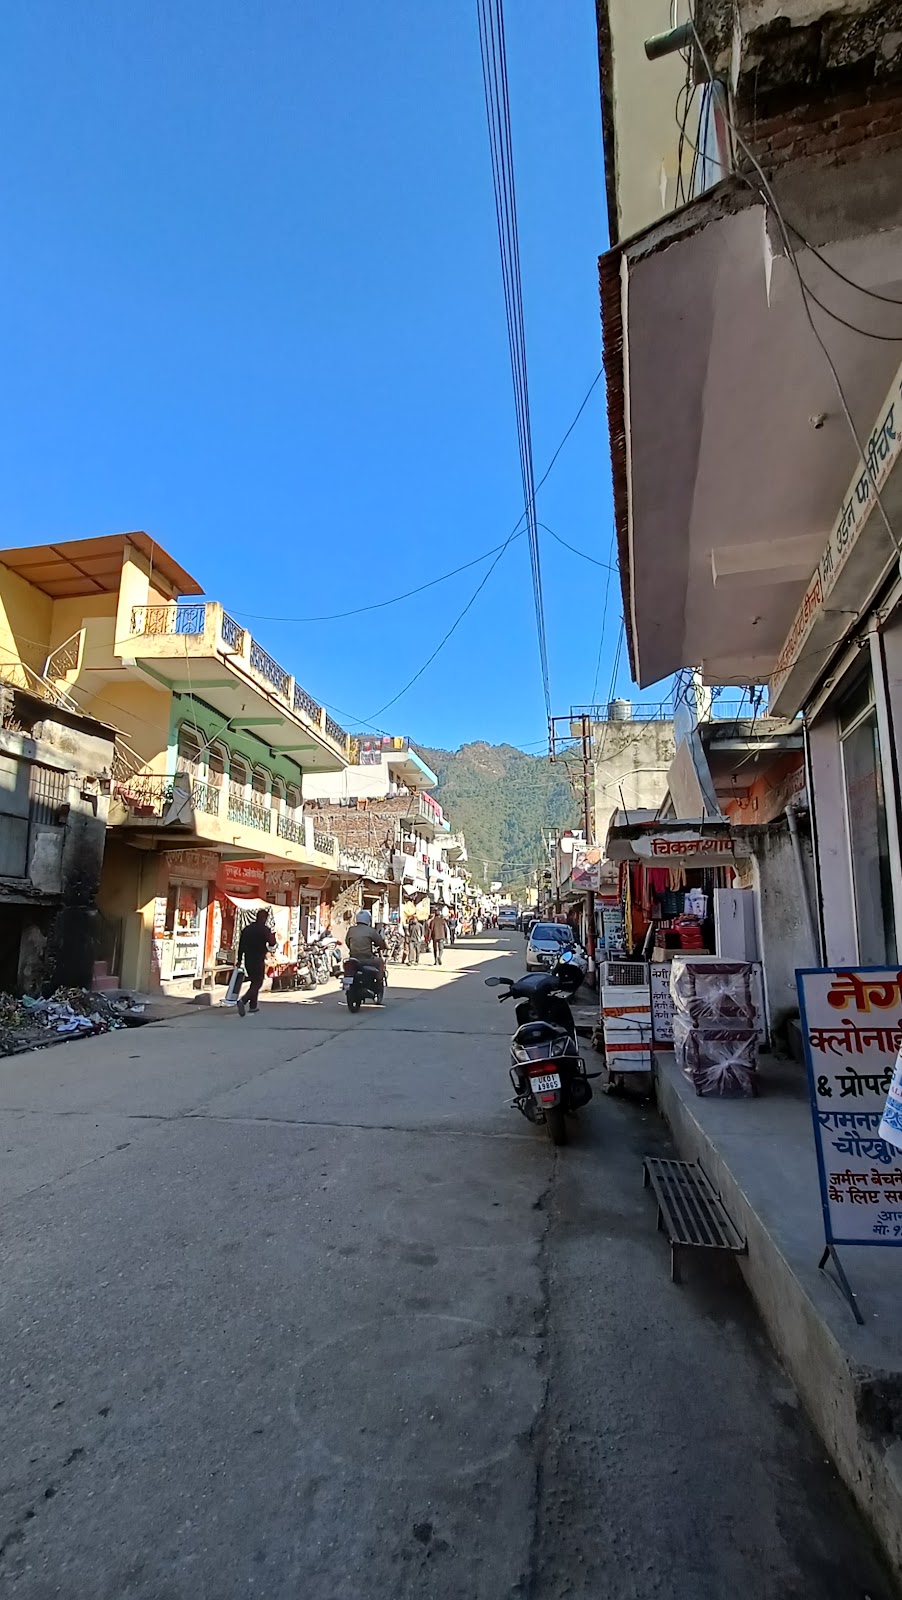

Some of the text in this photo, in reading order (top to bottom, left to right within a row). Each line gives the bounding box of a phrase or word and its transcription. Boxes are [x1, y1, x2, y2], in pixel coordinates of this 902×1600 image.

[651, 838, 703, 856] चिकन
[817, 1075, 833, 1098] &
[829, 1168, 868, 1186] जमीन
[829, 1186, 844, 1203] के
[846, 1186, 880, 1204] लिए
